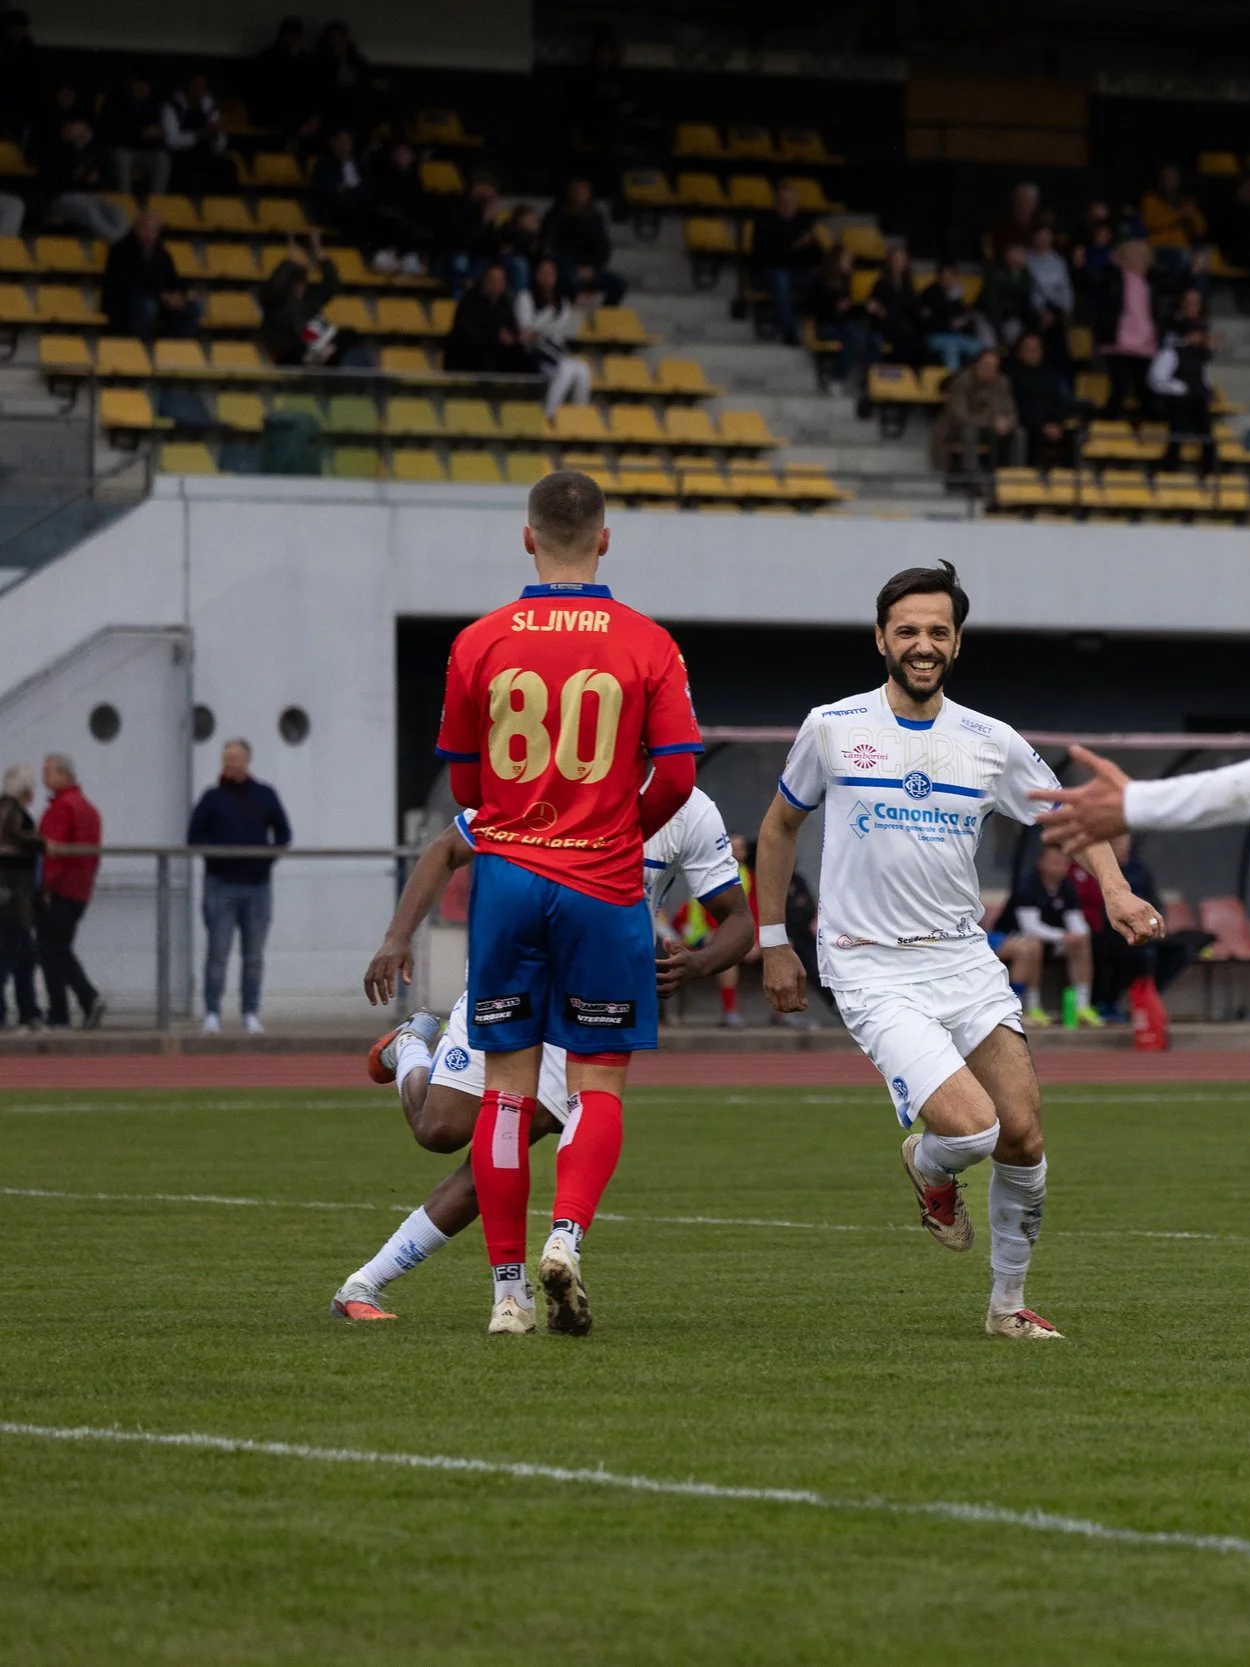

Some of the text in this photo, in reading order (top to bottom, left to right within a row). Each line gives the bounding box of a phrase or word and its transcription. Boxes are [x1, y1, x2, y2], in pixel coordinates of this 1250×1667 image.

[511, 610, 610, 633] SLJIVAR
[821, 707, 868, 718] PRIMATO
[488, 667, 623, 784] 80
[961, 718, 993, 735] RESPECT
[874, 803, 959, 825] Canonica
[576, 1014, 623, 1024] NTERBIKE
[496, 1265, 520, 1280] FS
